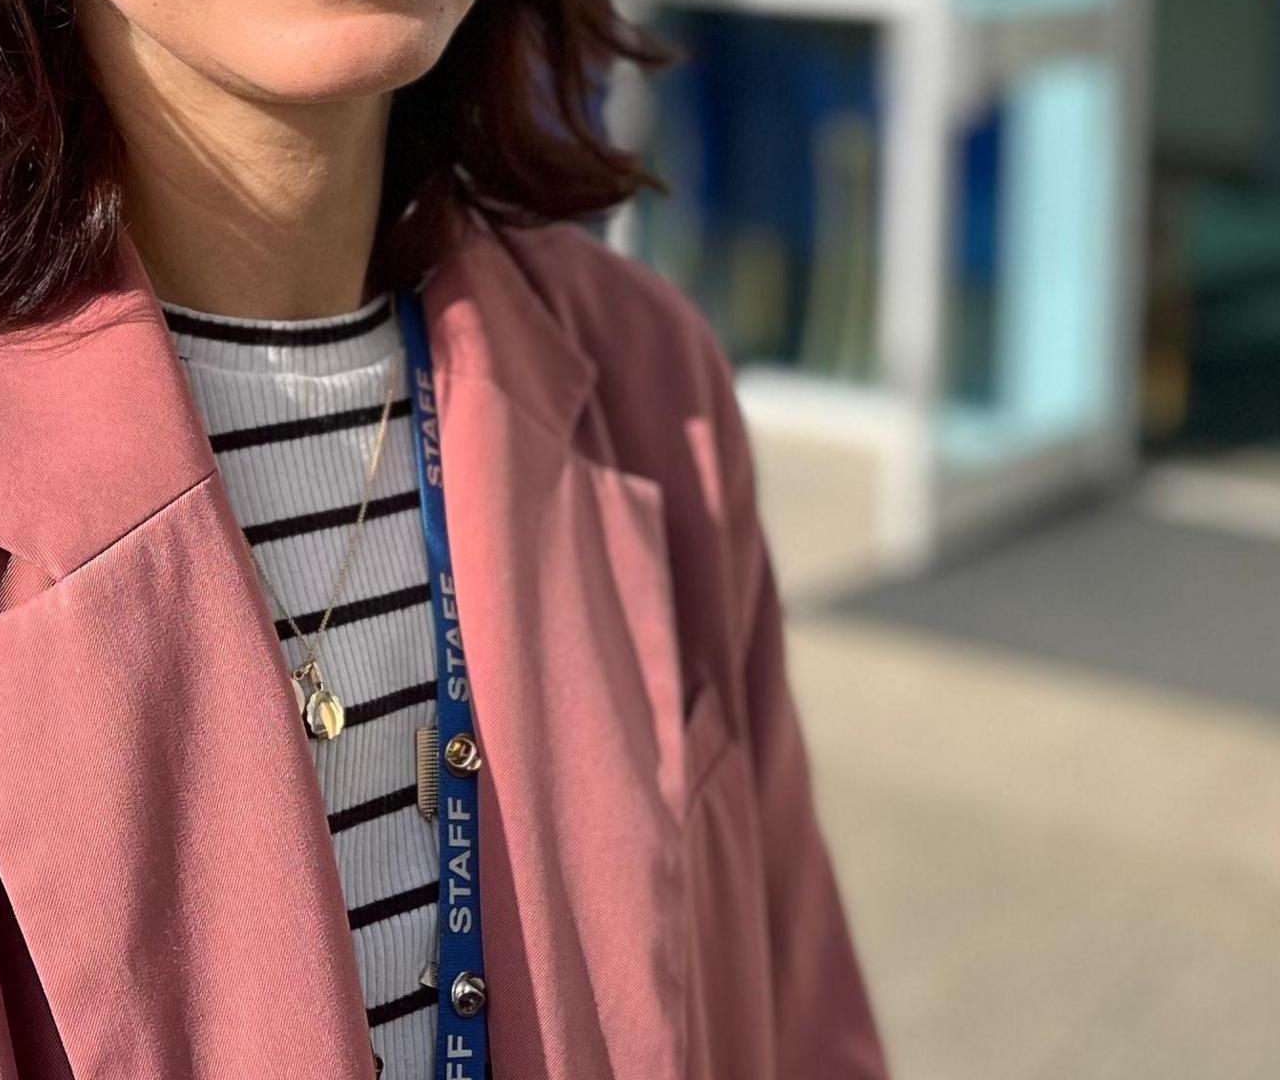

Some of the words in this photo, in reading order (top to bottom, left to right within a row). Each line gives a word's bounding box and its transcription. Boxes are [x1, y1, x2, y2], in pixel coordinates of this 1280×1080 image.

[417, 369, 442, 487] STAFF
[440, 572, 468, 703] STAFF
[447, 796, 472, 934] STAFF
